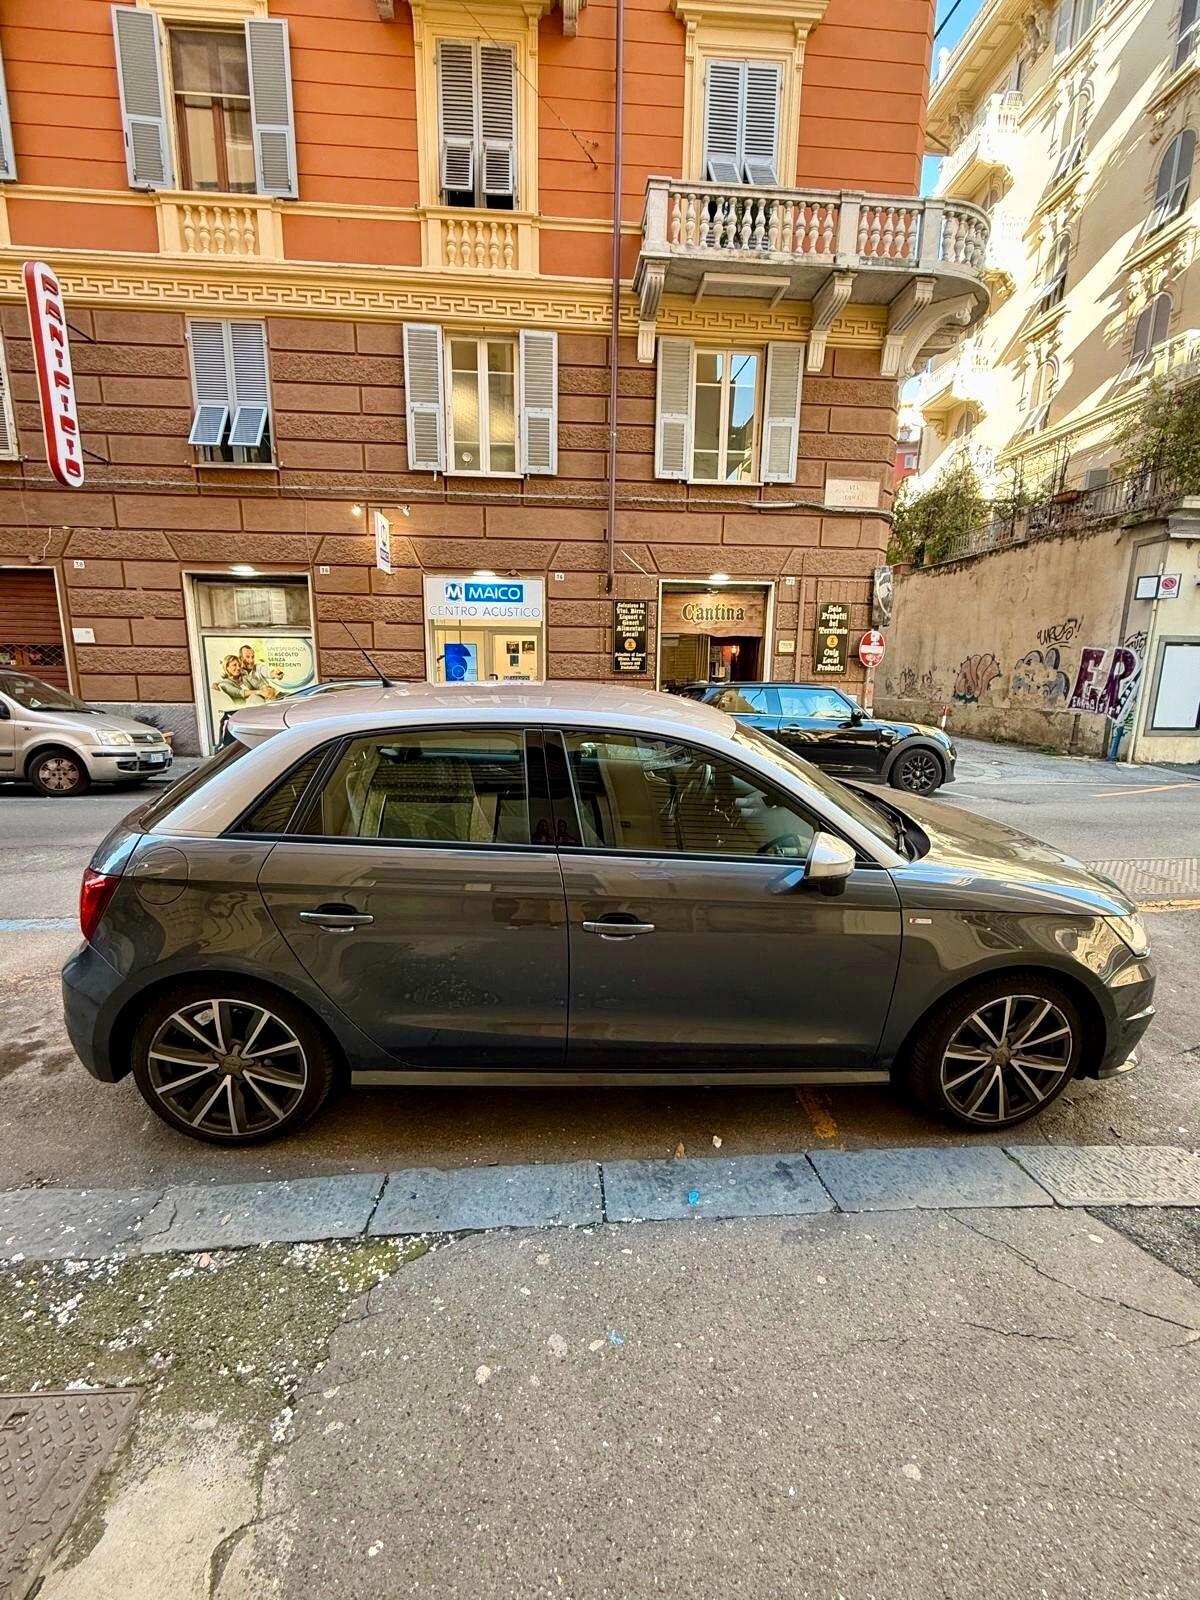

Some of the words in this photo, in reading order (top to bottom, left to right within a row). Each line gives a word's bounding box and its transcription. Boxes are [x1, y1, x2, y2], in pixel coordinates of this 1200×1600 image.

[469, 586, 520, 600] MAICO
[429, 605, 478, 616] CENTRO
[482, 606, 541, 617] ACUSTICO
[682, 602, 746, 624] Cantina
[828, 605, 842, 613] Solo
[824, 648, 840, 658] Only
